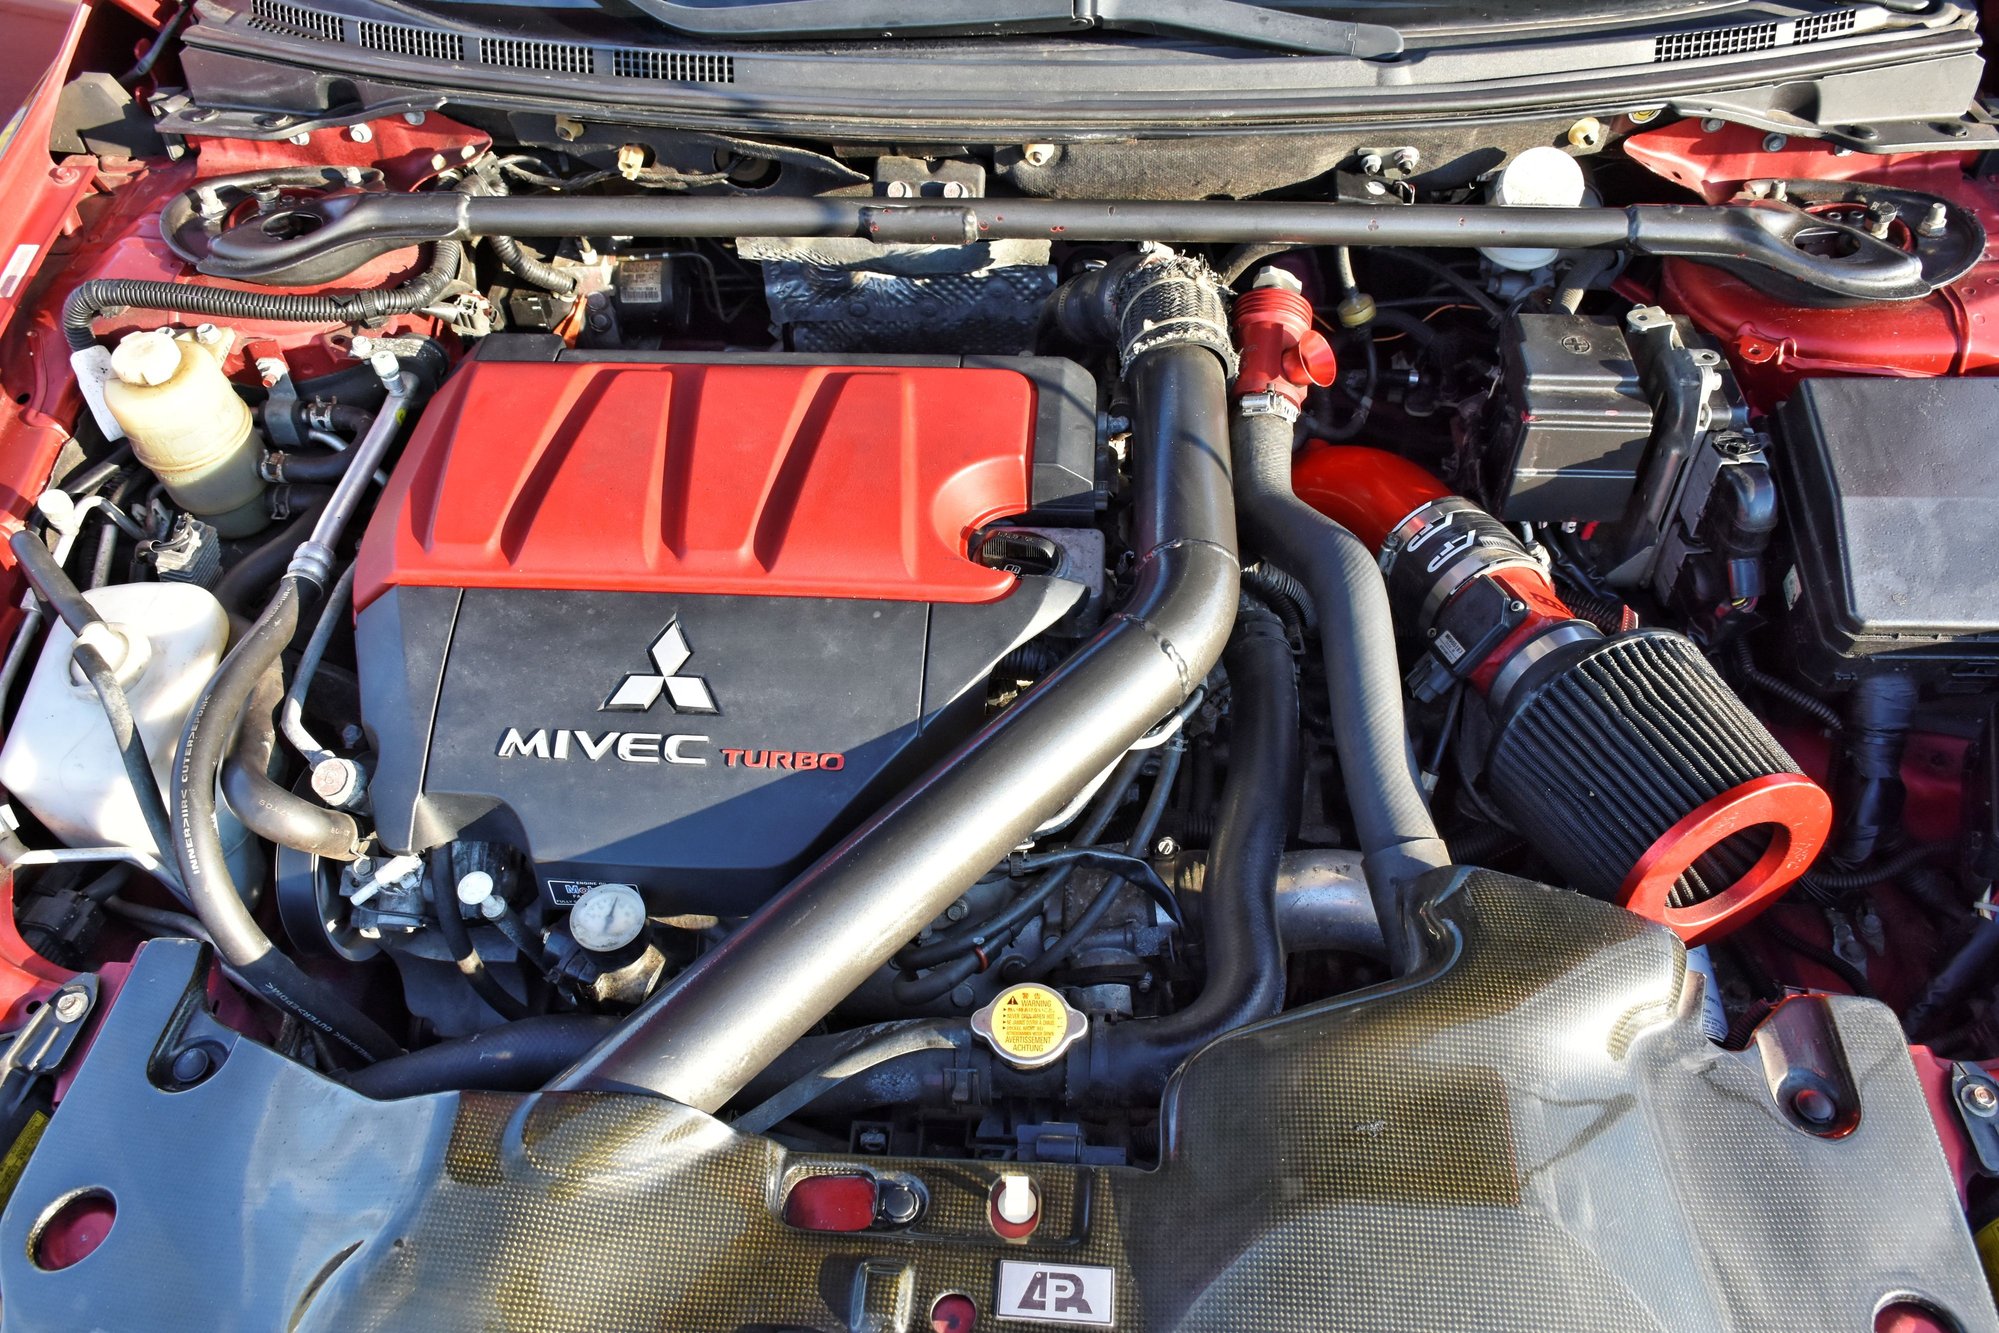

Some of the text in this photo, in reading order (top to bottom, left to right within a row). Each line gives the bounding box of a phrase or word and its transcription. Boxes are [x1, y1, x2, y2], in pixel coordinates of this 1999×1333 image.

[498, 727, 847, 772] MIVEC TURBO
[1005, 1036, 1052, 1044] AVERTISSEMENT
[1013, 1044, 1044, 1052] ACHTUNG
